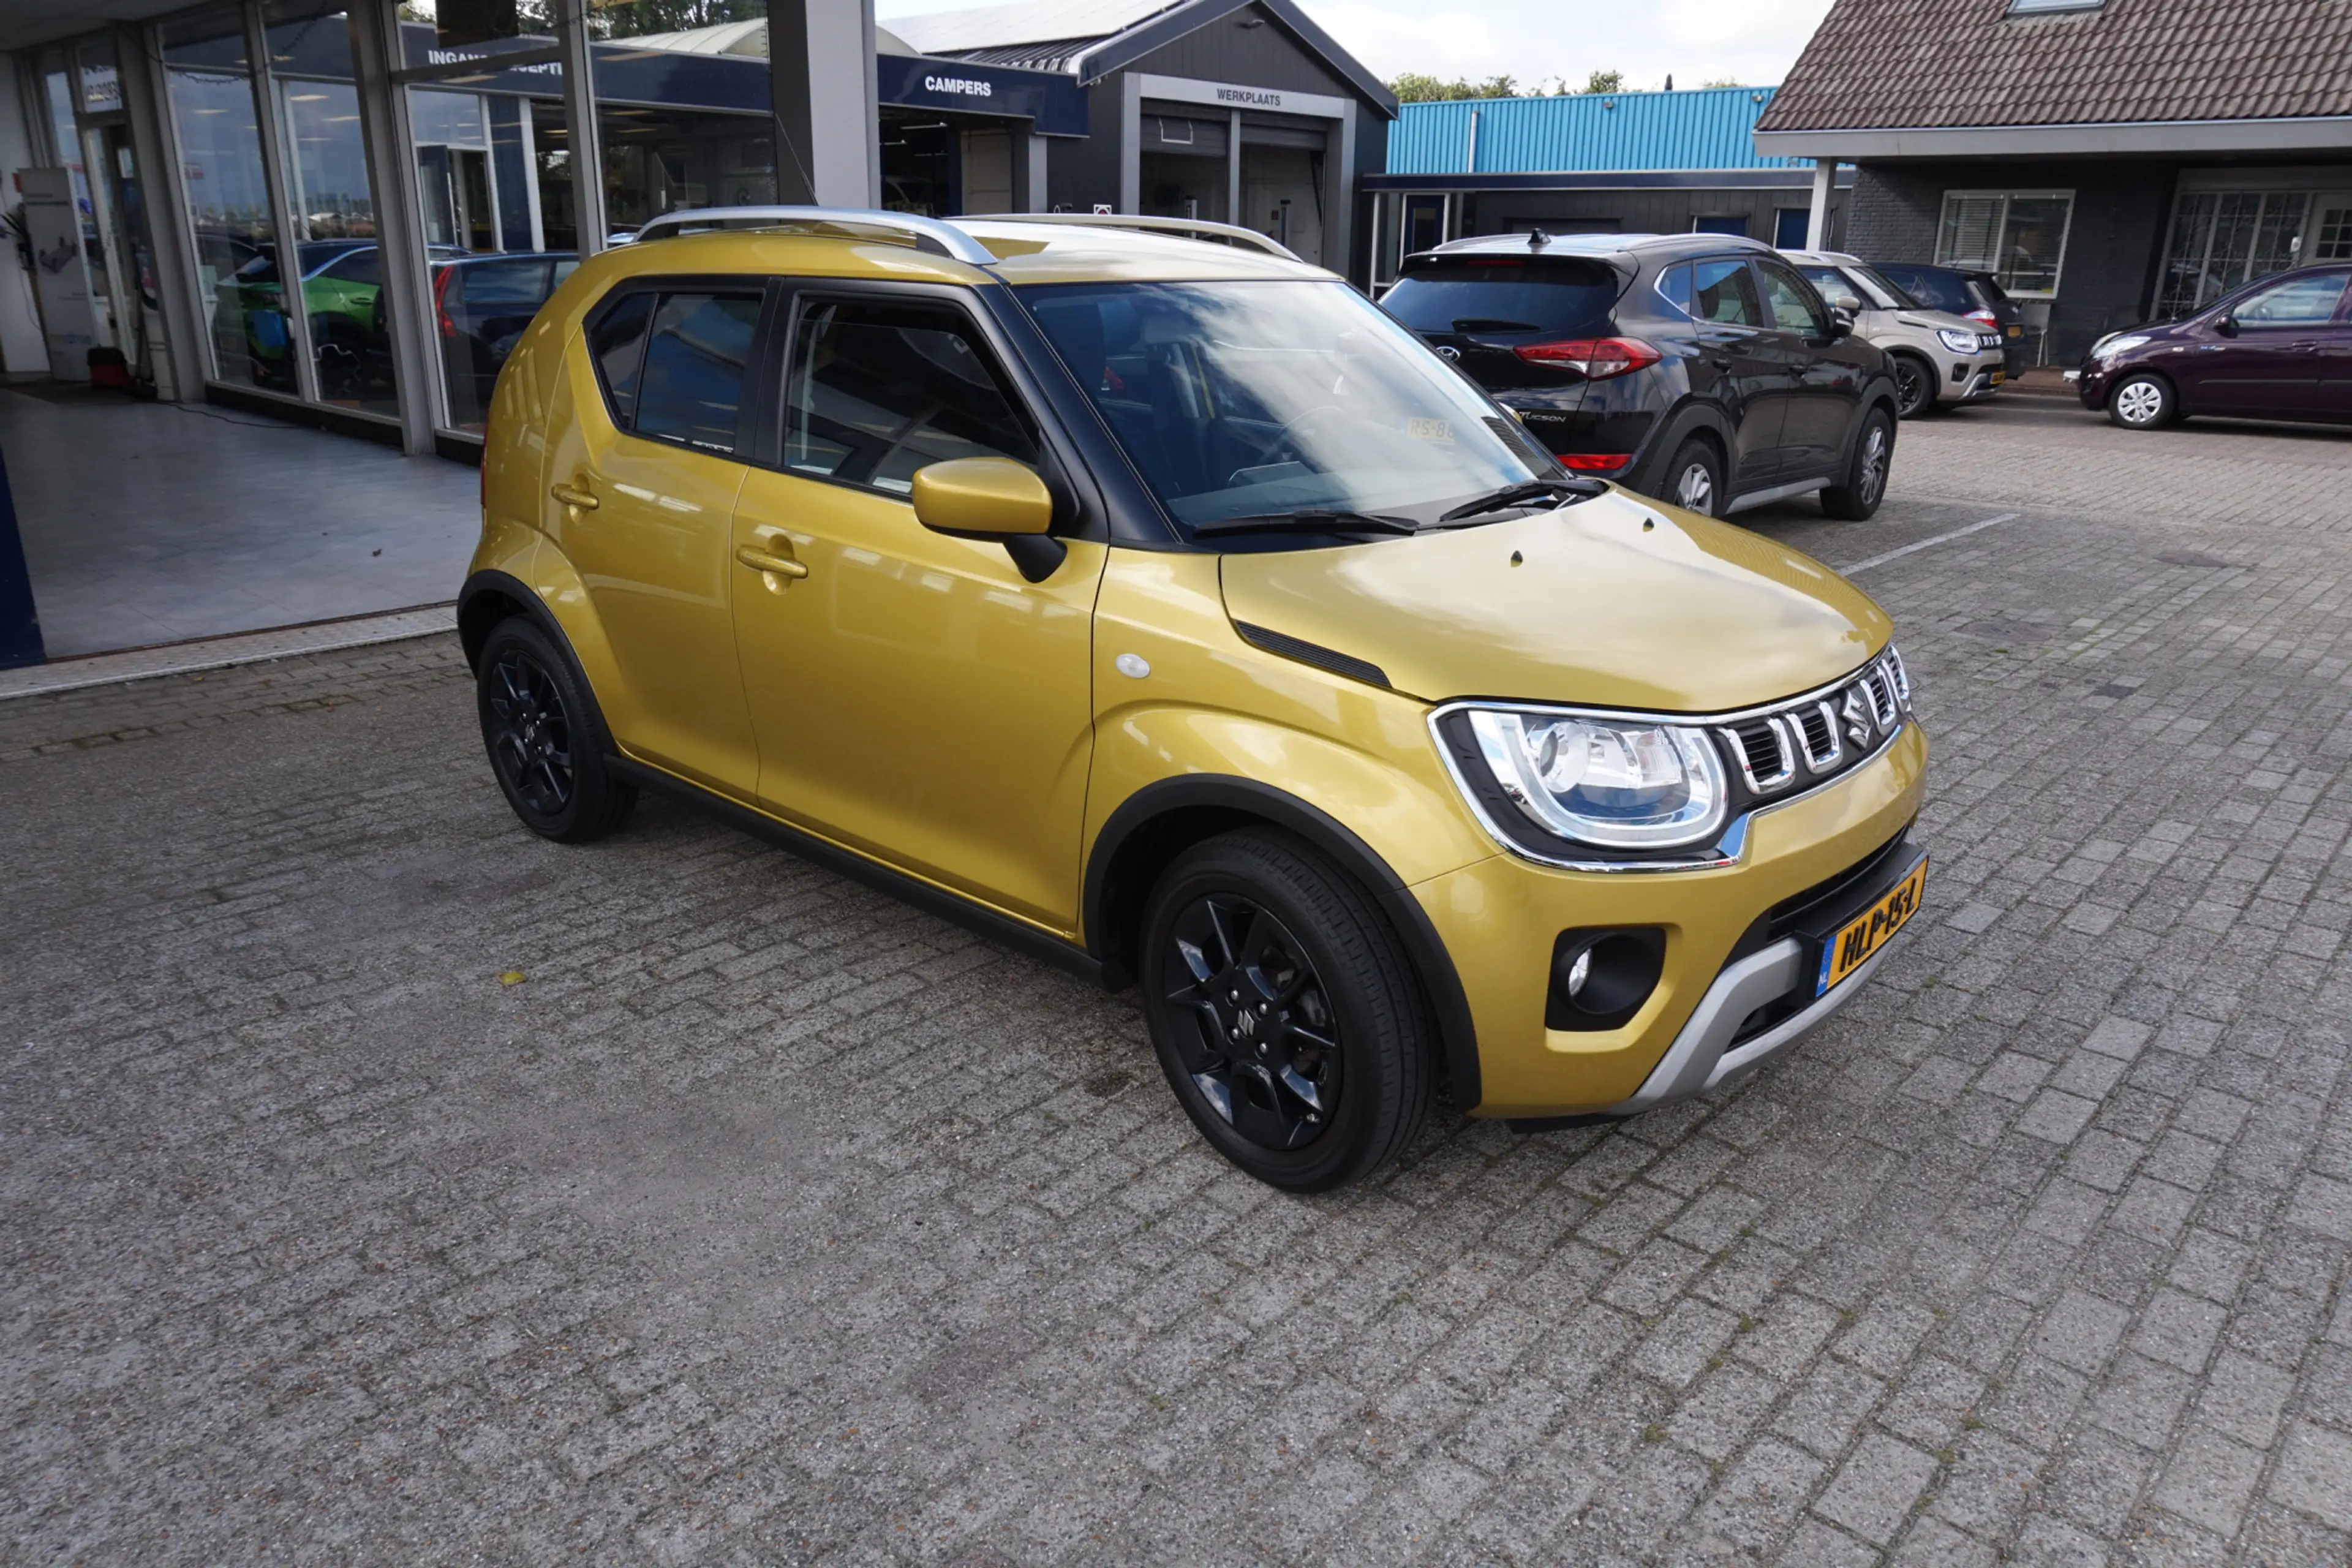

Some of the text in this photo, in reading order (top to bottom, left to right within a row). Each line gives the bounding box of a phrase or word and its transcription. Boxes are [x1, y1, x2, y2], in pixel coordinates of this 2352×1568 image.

[428, 50, 488, 64] INGA
[925, 76, 992, 96] CAMPERS
[1216, 88, 1281, 107] WERKPLAATS
[1839, 877, 1917, 973] HLP-15-L
[1817, 971, 1827, 987] NL
